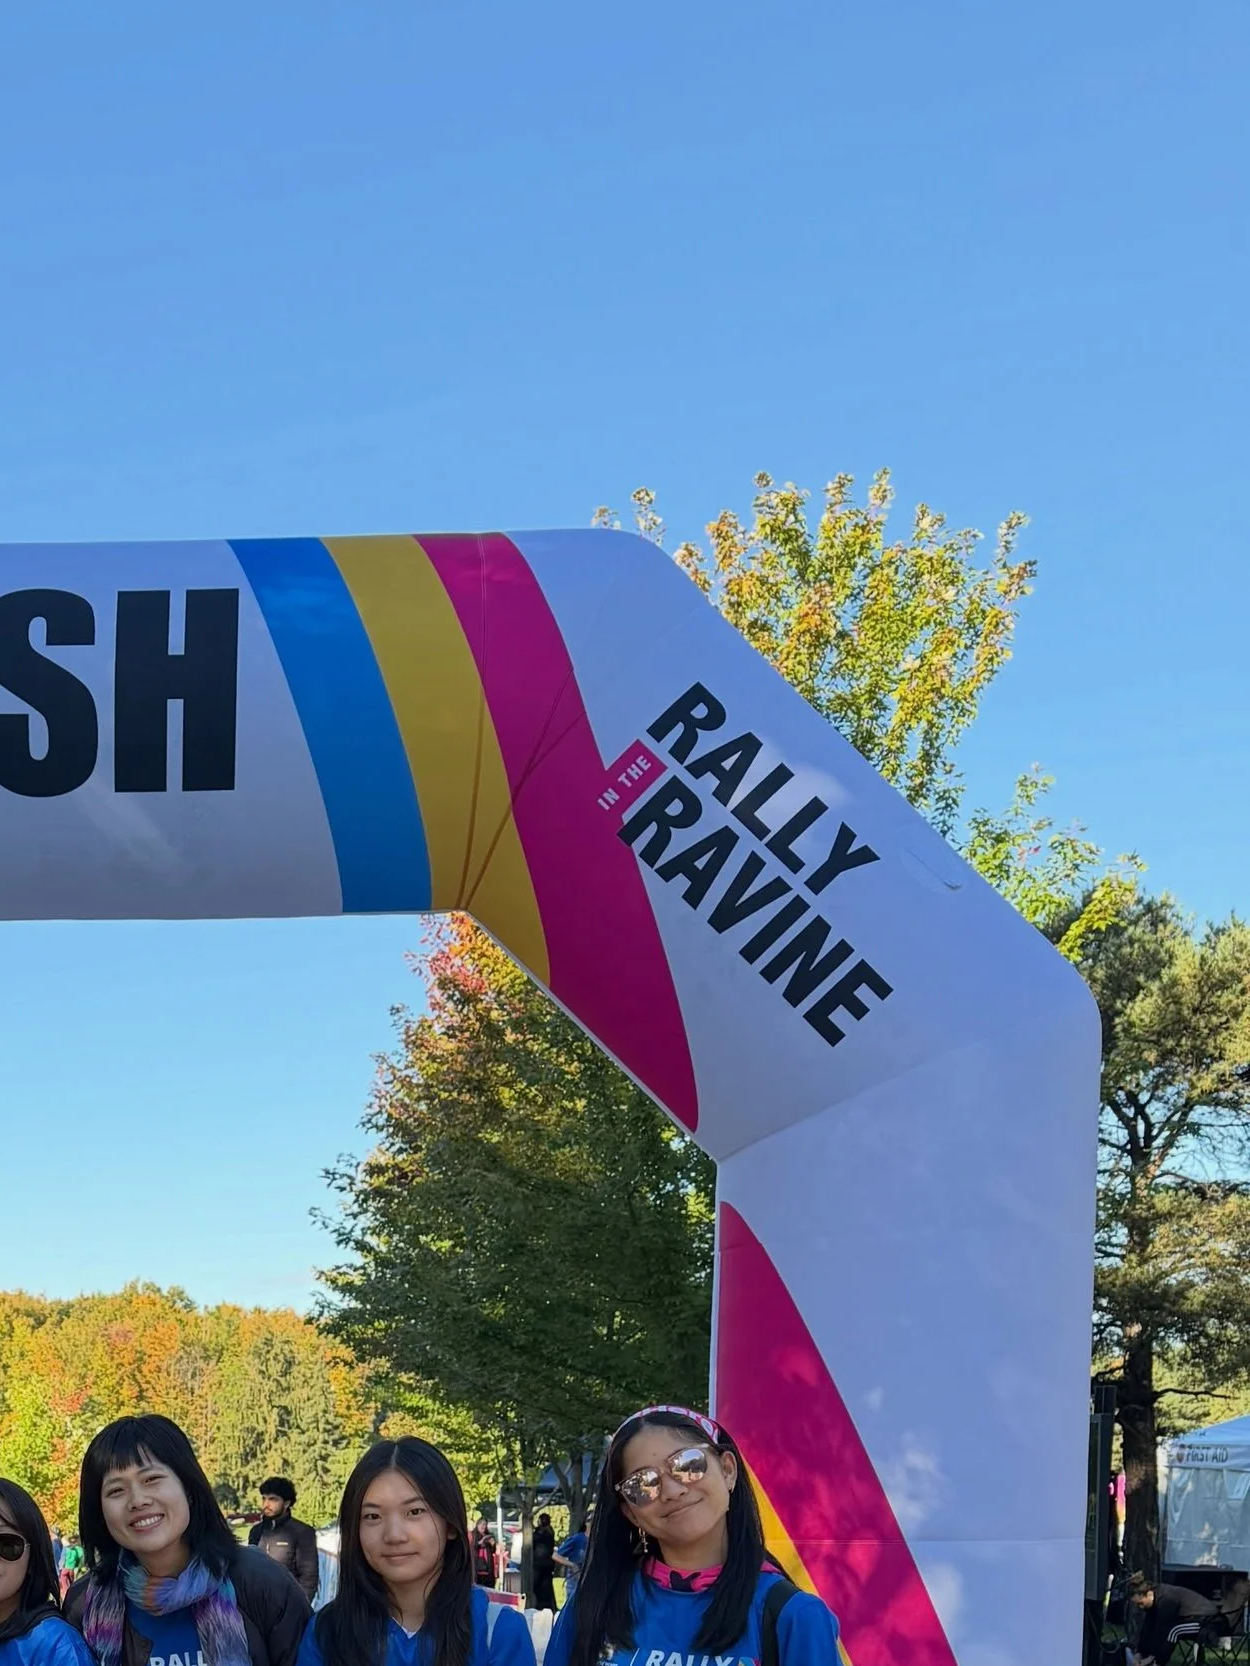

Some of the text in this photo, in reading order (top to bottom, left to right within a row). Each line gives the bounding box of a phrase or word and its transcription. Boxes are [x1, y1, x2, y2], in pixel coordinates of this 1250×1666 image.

[597, 755, 652, 811] IN THE
[646, 681, 881, 896] RALLY
[616, 775, 894, 1048] RAVINE
